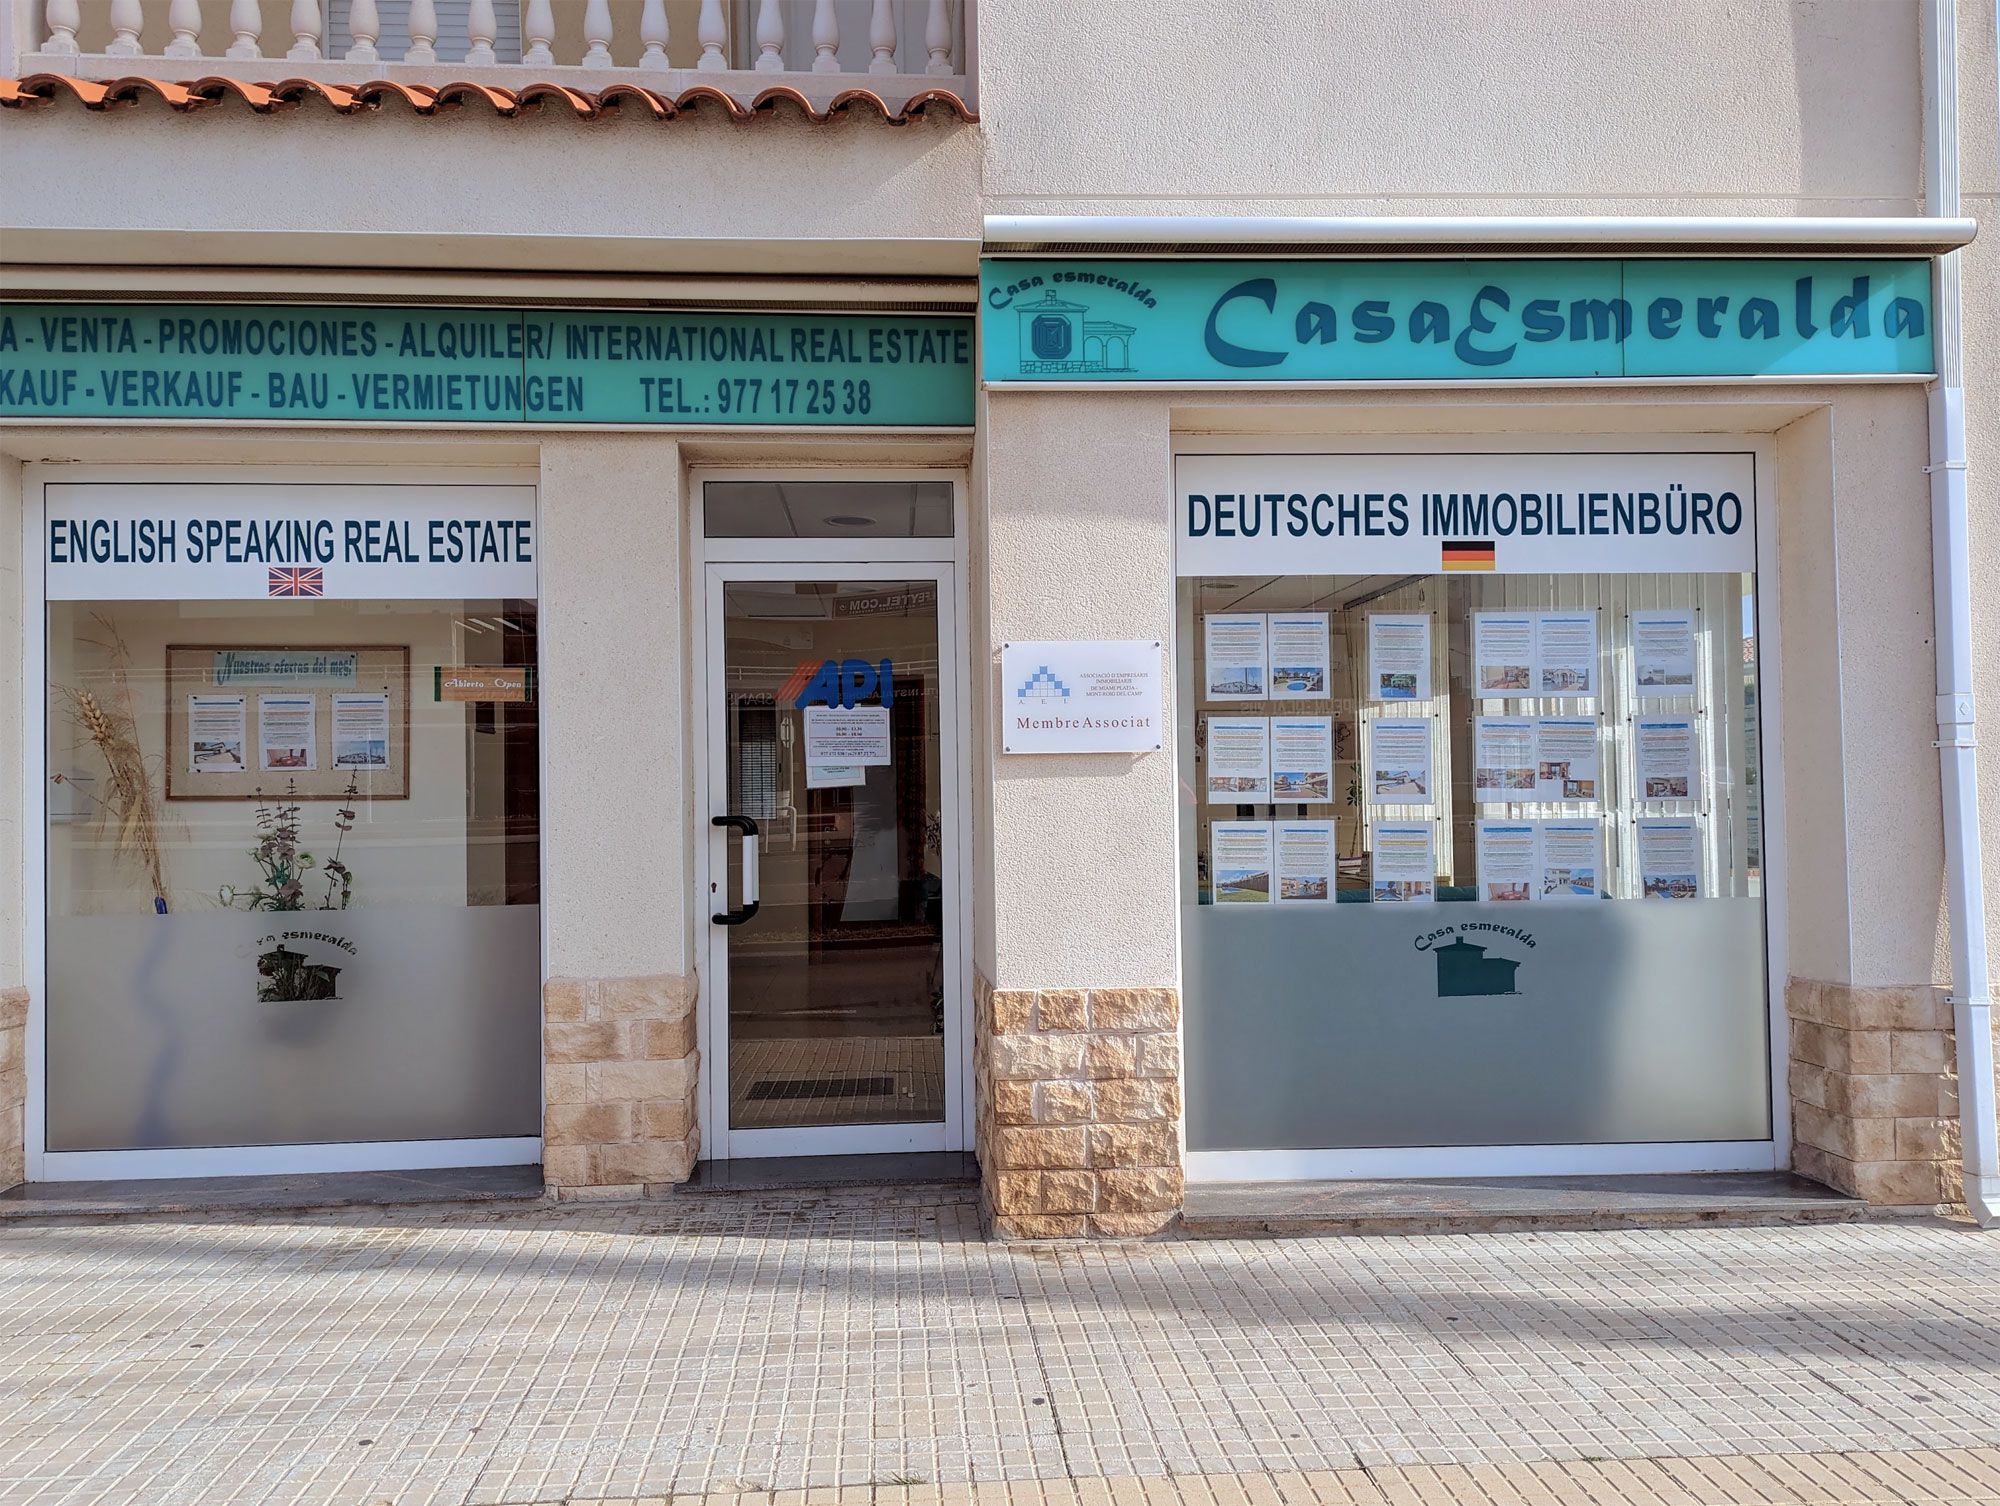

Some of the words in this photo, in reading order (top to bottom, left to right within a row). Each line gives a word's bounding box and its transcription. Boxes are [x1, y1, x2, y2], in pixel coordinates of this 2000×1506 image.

[987, 274, 1044, 311] Casa
[1052, 270, 1158, 310] esmeralda
[40, 316, 137, 354] VENTA
[158, 318, 378, 357] PROMOCIONES
[566, 324, 784, 363] INTERNATIONAL
[791, 328, 862, 364] REAL
[869, 328, 969, 365] ESTATE
[100, 370, 243, 408] VERKAUF
[268, 372, 329, 410] BAU
[352, 374, 584, 412] VERMIETUNGEN
[640, 377, 710, 414] TEL.:
[1188, 493, 1410, 538] DEUTSCHES
[1422, 483, 1742, 537] IMMOBILIENBÜRO
[51, 519, 176, 564] ENGLISH
[187, 519, 335, 564] SPEAKING
[345, 520, 419, 563] REAL
[429, 520, 532, 563] ESTATE
[217, 651, 270, 686] Nuestras
[273, 659, 310, 674] ofertas
[313, 656, 327, 674] del
[444, 678, 484, 688] Abierto
[495, 678, 522, 690] Open
[795, 658, 894, 710] API
[1017, 716, 1080, 730] Membre
[1082, 715, 1151, 729] Associat
[1414, 926, 1455, 952] Casa
[1460, 922, 1537, 949] esmeralda
